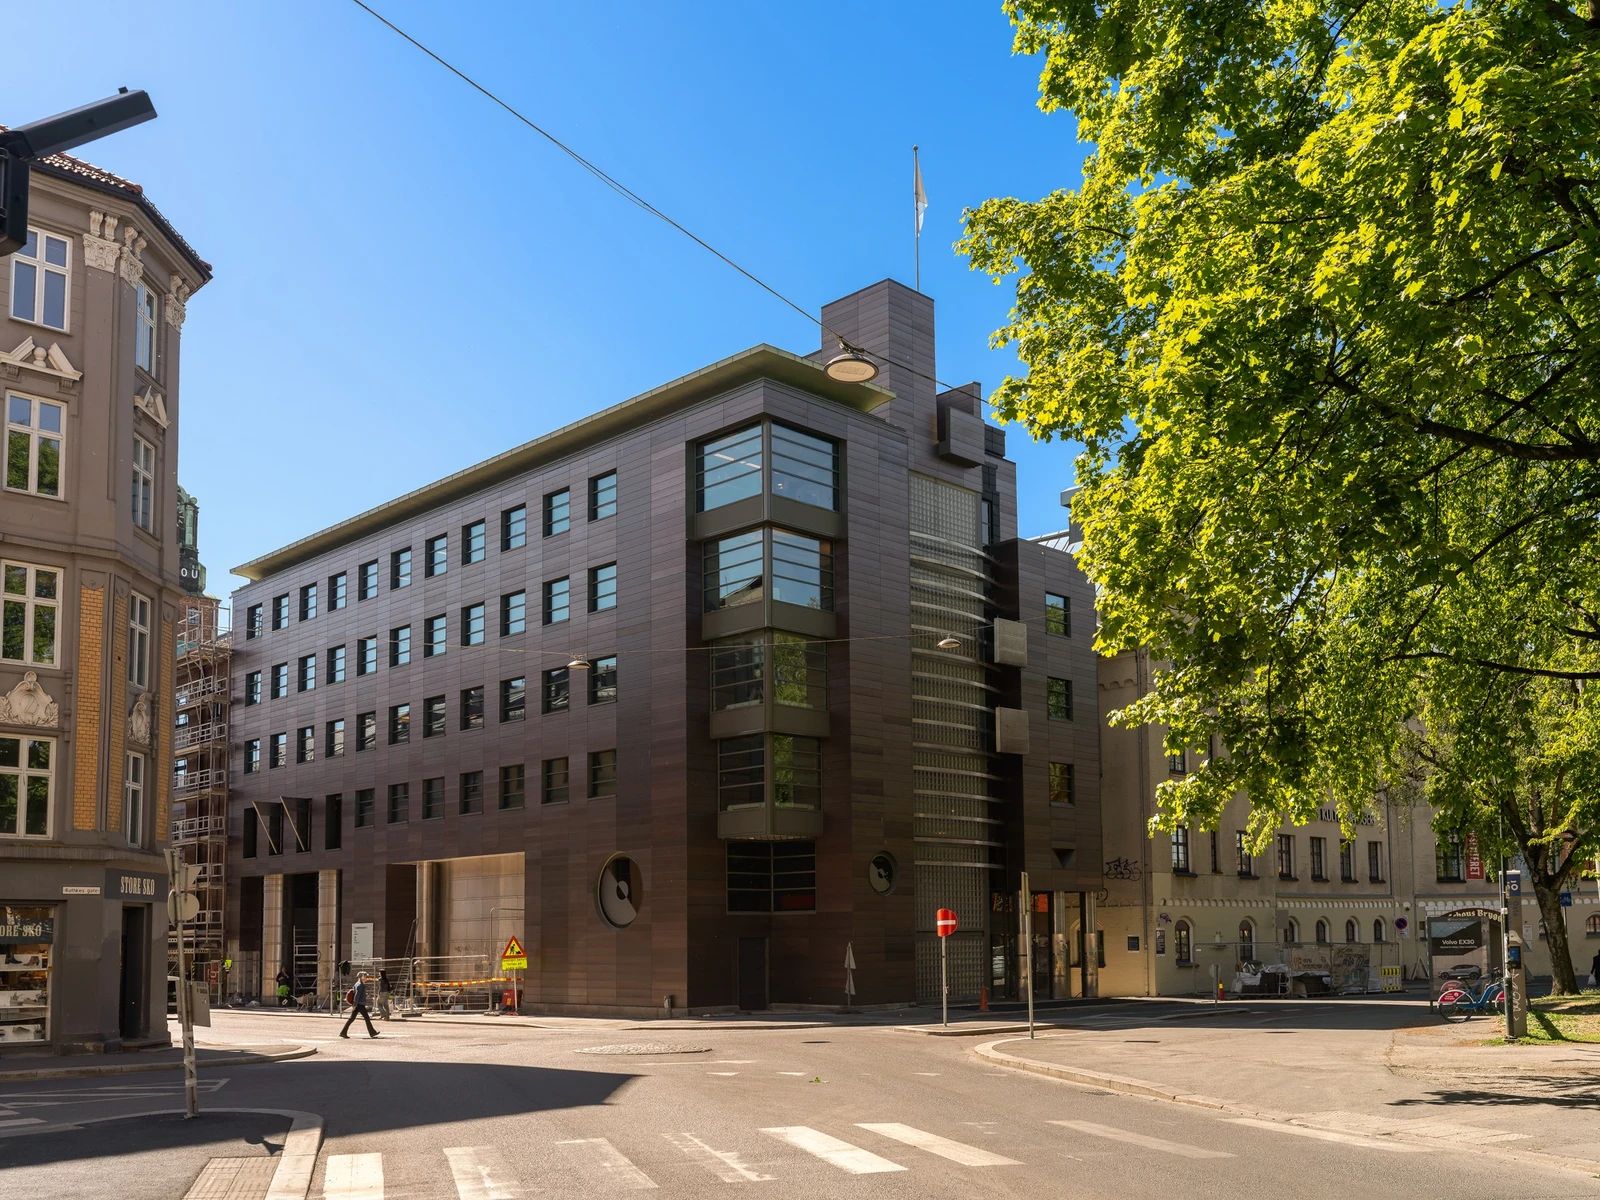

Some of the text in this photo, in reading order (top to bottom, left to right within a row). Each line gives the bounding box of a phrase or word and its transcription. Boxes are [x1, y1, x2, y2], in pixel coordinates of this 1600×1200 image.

[120, 876, 155, 896] STORE SKO
[1477, 909, 1503, 922] Brygg
[0, 925, 42, 937] ORE SKO
